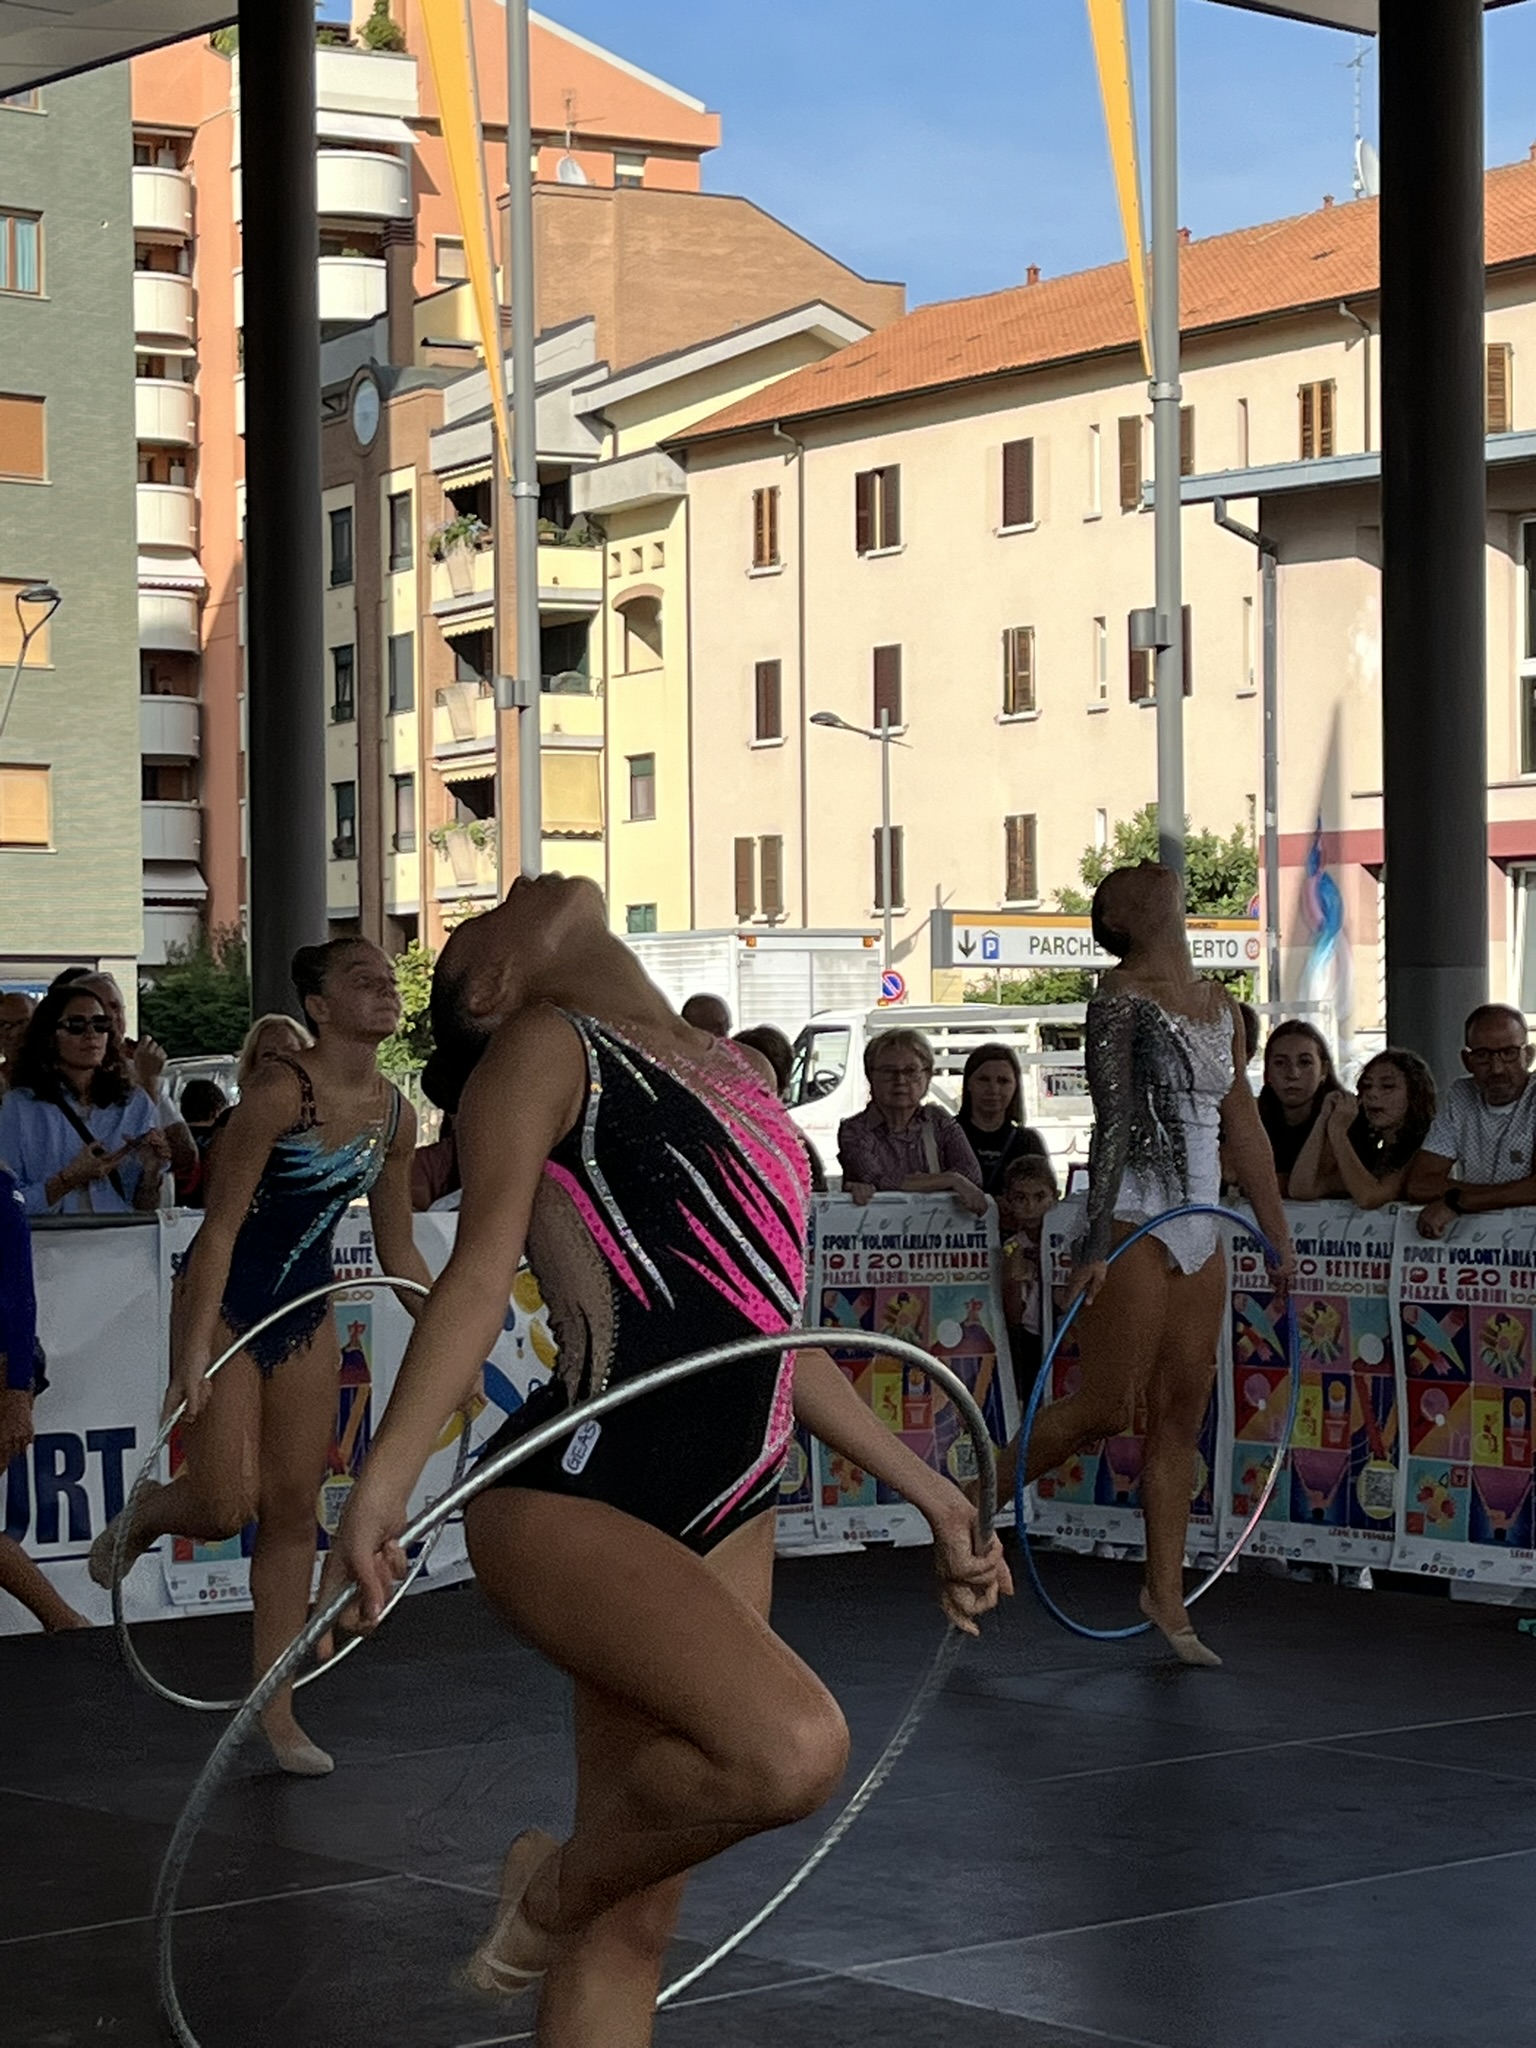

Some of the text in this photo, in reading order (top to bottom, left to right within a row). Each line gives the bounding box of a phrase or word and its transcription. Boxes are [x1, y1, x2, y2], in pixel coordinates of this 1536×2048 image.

[1029, 936, 1112, 957] PARCHE
[1188, 939, 1239, 958] ERTO
[822, 1234, 988, 1250] SPORT VOLONTARIATO SALUTE
[1290, 1238, 1361, 1257] ONTARIATO
[1366, 1242, 1394, 1258] SAL
[334, 1247, 373, 1264] ALUTE
[853, 1253, 861, 1269] E
[867, 1253, 903, 1269] 20
[908, 1252, 988, 1269] SETTEMBRE
[1403, 1246, 1444, 1263] SPORT
[822, 1271, 861, 1286] PIAZZA
[1232, 1273, 1268, 1289] PIAZZ
[1438, 1267, 1448, 1285] E
[1457, 1268, 1501, 1286] 20
[1400, 1285, 1449, 1300] PIAZZA
